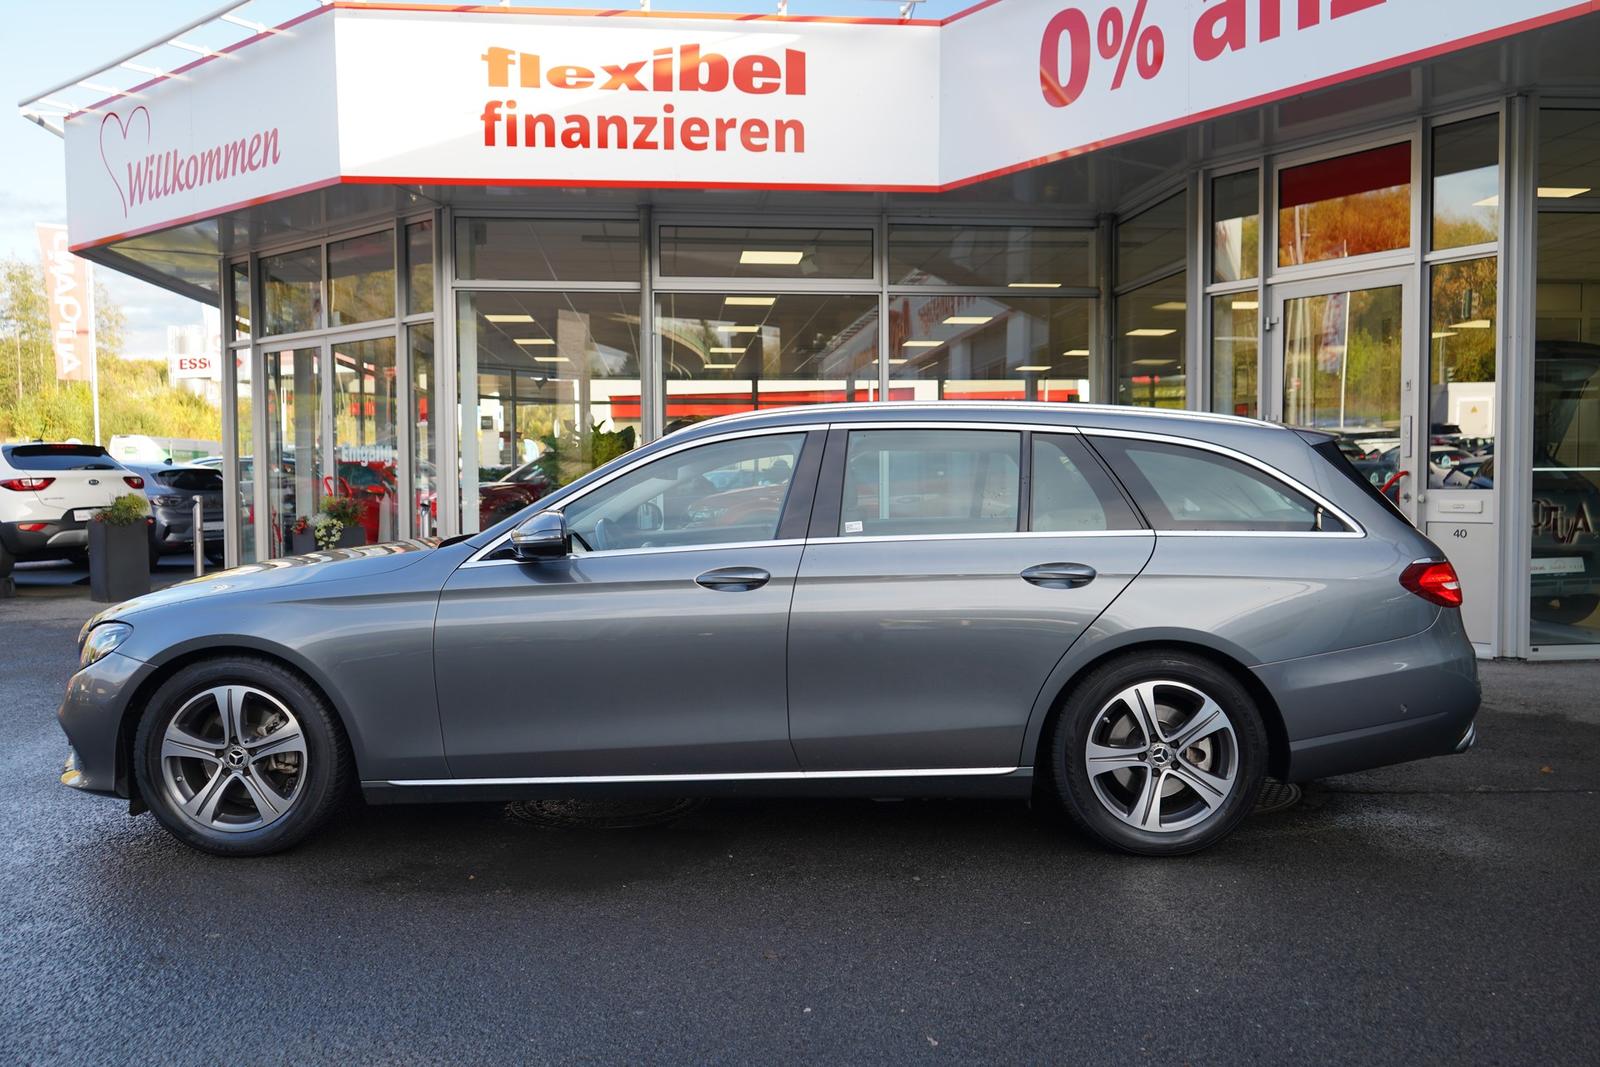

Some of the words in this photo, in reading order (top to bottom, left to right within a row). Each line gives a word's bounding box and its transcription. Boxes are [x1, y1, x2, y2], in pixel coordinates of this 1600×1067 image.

[481, 43, 806, 95] flexibel
[1040, 0, 1164, 108] 0%
[480, 100, 805, 153] finanzieren
[127, 127, 281, 208] Willkommen
[1453, 529, 1467, 538] 40
